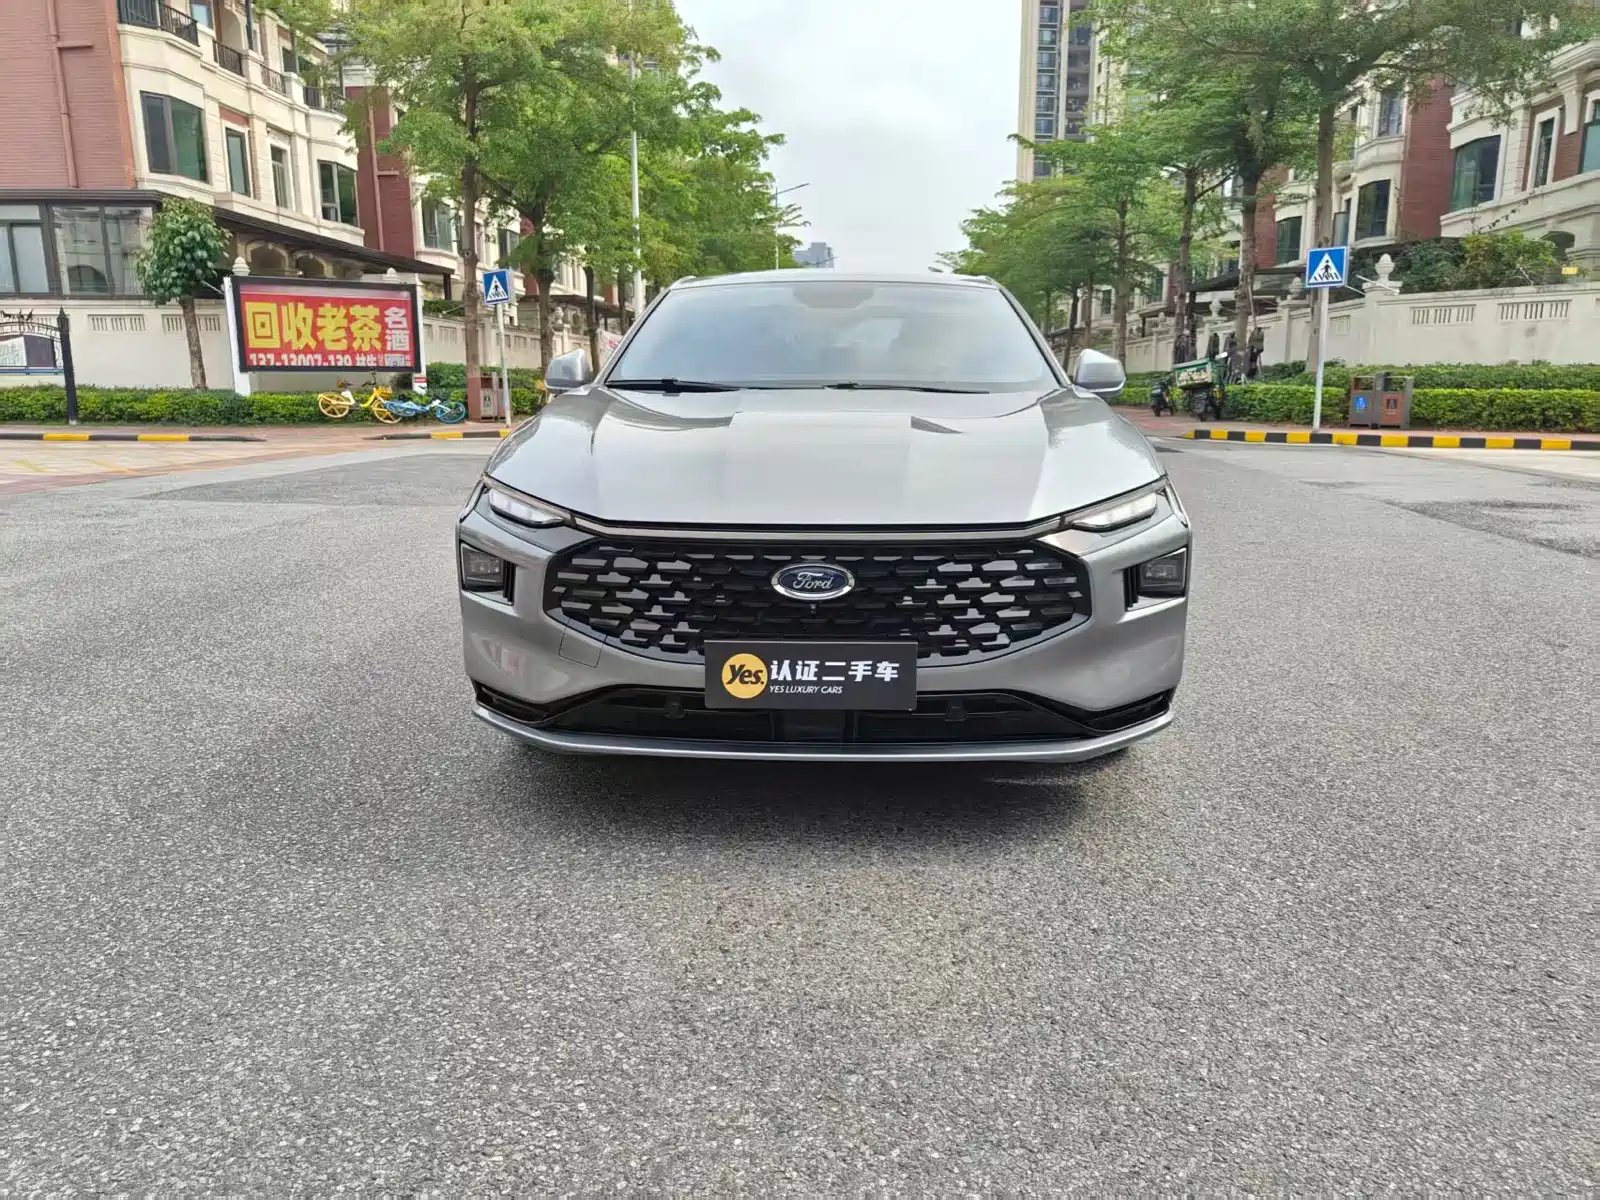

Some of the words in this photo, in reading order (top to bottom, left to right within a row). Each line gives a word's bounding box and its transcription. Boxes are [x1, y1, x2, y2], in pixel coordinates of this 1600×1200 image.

[245, 302, 382, 351] 回收老茶
[384, 306, 409, 350] 名酒
[792, 571, 835, 589] Ford
[770, 659, 900, 682] 认证二手车
[769, 685, 785, 694] YES
[785, 685, 820, 694] LUXURY
[820, 686, 844, 694] CARS
